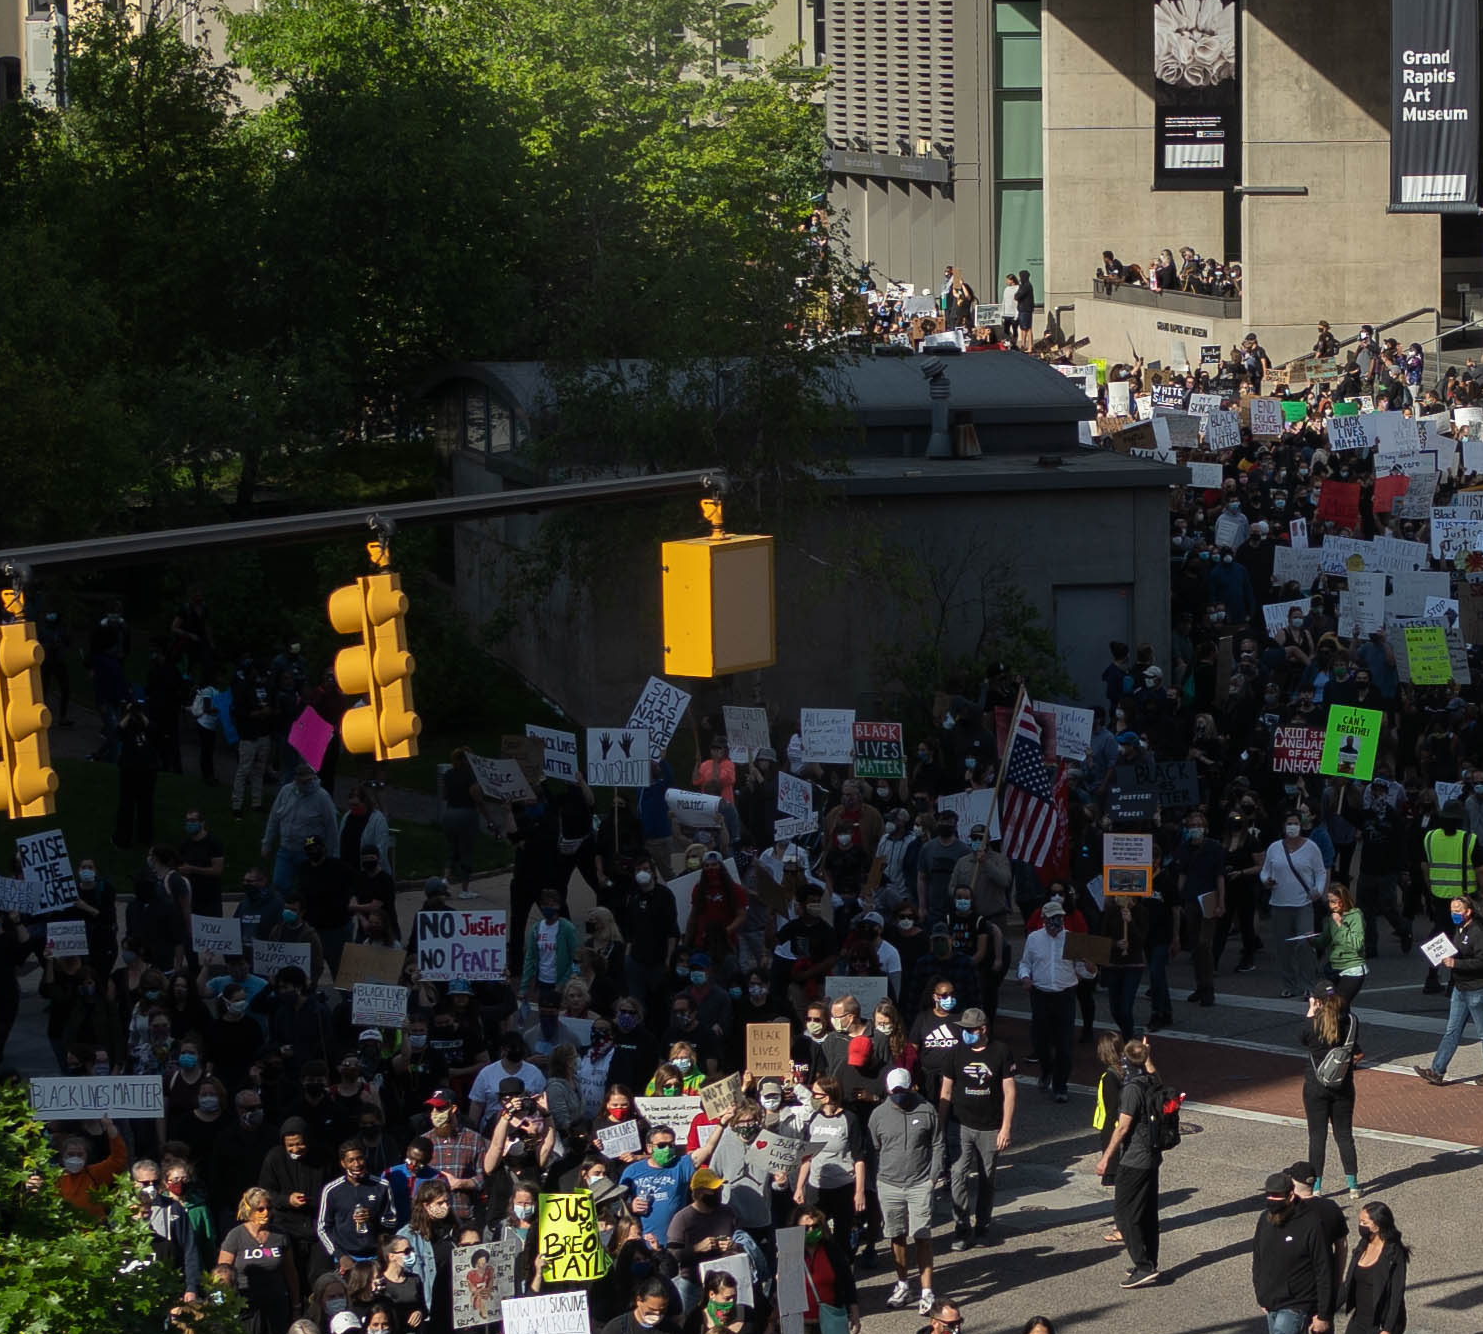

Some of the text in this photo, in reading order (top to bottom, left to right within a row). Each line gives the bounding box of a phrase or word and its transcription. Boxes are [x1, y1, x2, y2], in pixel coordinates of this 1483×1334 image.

[1402, 49, 1451, 65] Grand
[1402, 68, 1456, 87] Rapids
[1402, 88, 1431, 103] Art
[1402, 107, 1469, 122] Museum
[1153, 385, 1185, 397] WHITE
[1257, 400, 1275, 414] END
[1333, 417, 1361, 429] BLACK
[1338, 427, 1365, 437] LIVES
[1334, 436, 1368, 449] MATTER
[1427, 600, 1446, 617] STOP
[650, 682, 687, 708] SAY
[643, 693, 678, 720] HIS
[634, 703, 676, 733] NAME
[855, 724, 898, 739] BLACK
[1274, 727, 1309, 739] A RIOT
[557, 735, 576, 755] LIVES
[856, 741, 899, 758] LIVES
[1288, 749, 1301, 757] OF
[614, 760, 648, 785] SHOOT
[856, 760, 903, 775] MATTER
[1118, 810, 1144, 818] PEACE!
[19, 835, 67, 867] RAISE
[34, 862, 60, 881] THE
[200, 922, 221, 934] YOU
[420, 912, 455, 940] NO
[194, 938, 233, 951] MATTER
[267, 942, 286, 952] WE
[254, 952, 309, 965] SUPPORT
[420, 942, 502, 973] NO PEACE
[752, 1028, 781, 1041] BLACK
[751, 1045, 781, 1056] LIVES
[925, 1038, 959, 1049] adidas
[754, 1061, 784, 1071] MATTER
[30, 1081, 162, 1109] BLACK LIVES MATTER
[770, 1148, 796, 1161] LIVES
[549, 1294, 588, 1314] SURVIVE
[523, 1316, 586, 1334] AMERICA
